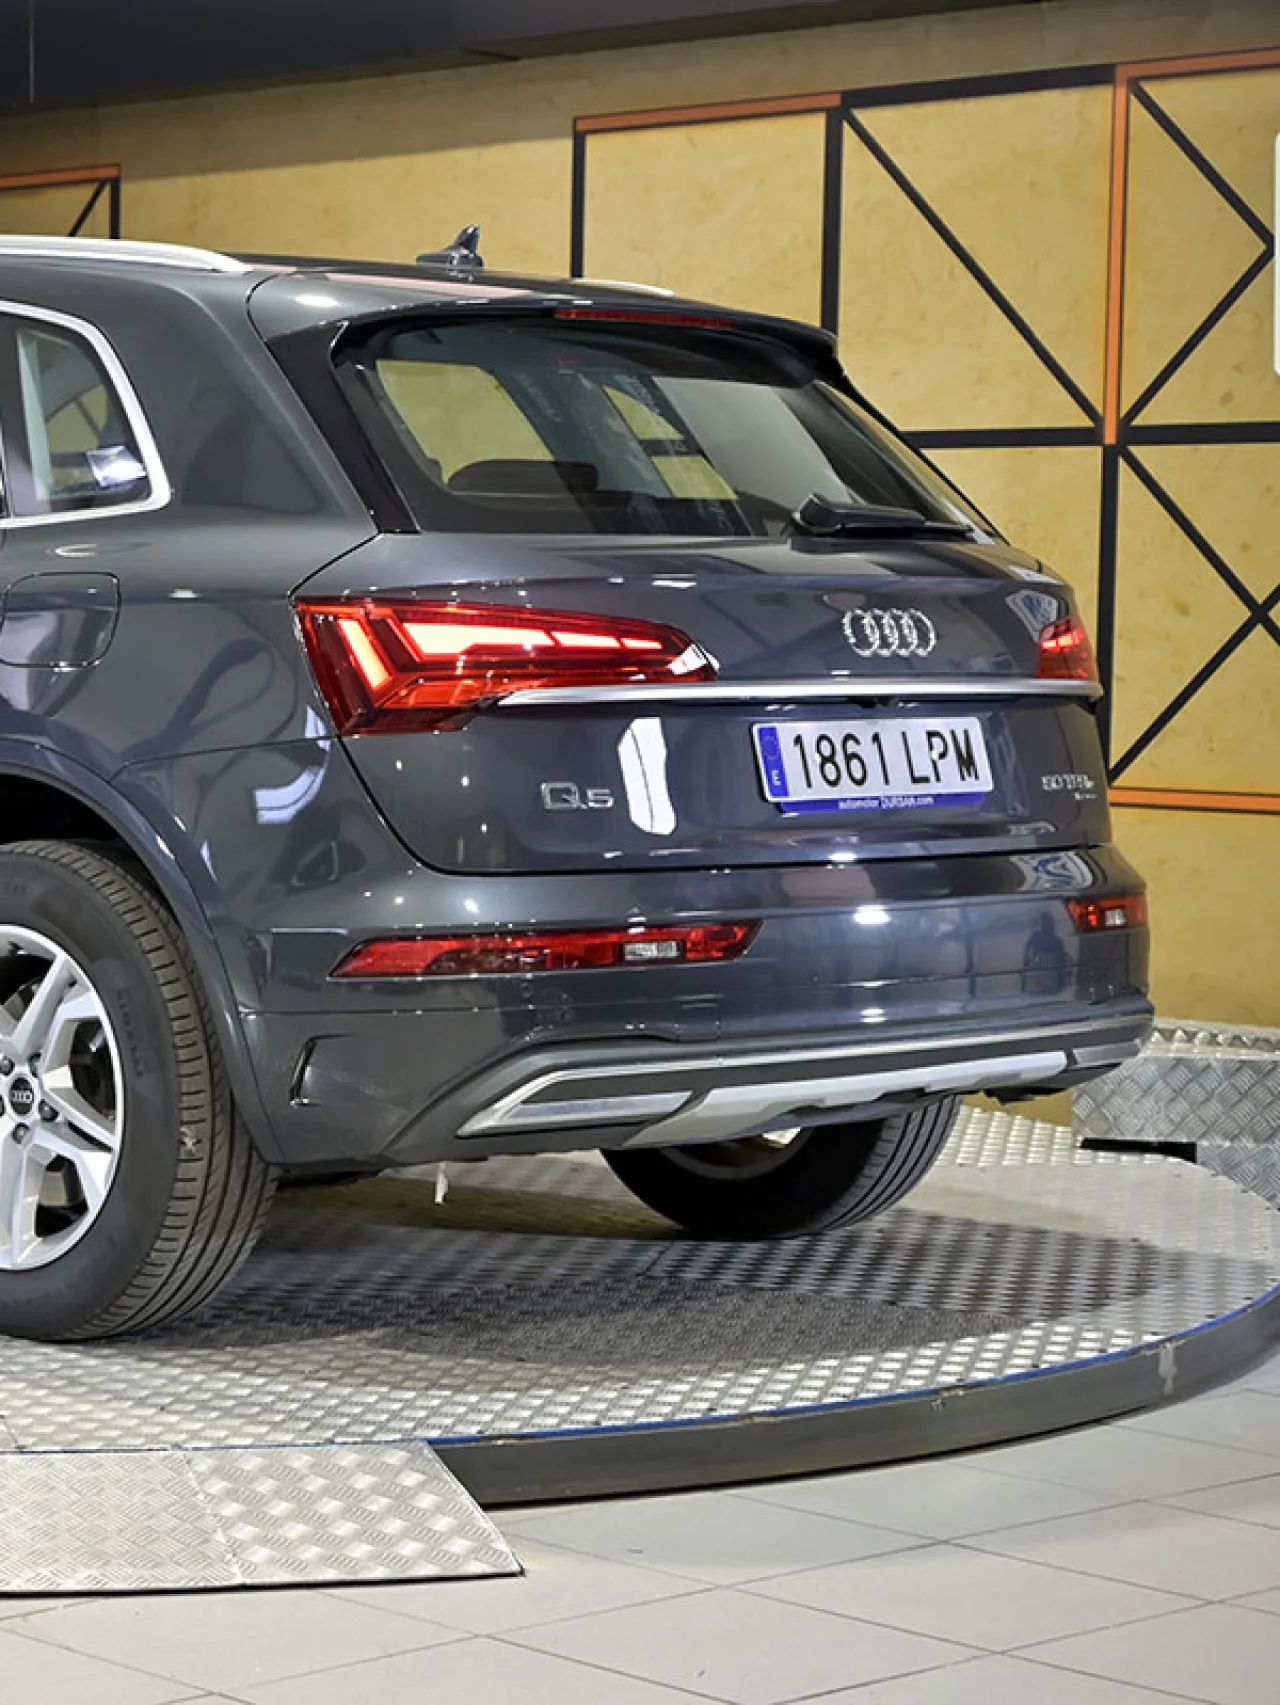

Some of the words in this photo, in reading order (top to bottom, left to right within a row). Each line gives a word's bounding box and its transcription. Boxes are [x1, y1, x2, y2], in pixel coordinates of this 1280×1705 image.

[793, 730, 890, 789] 1861
[901, 728, 981, 784] LPM
[540, 782, 615, 810] Q5
